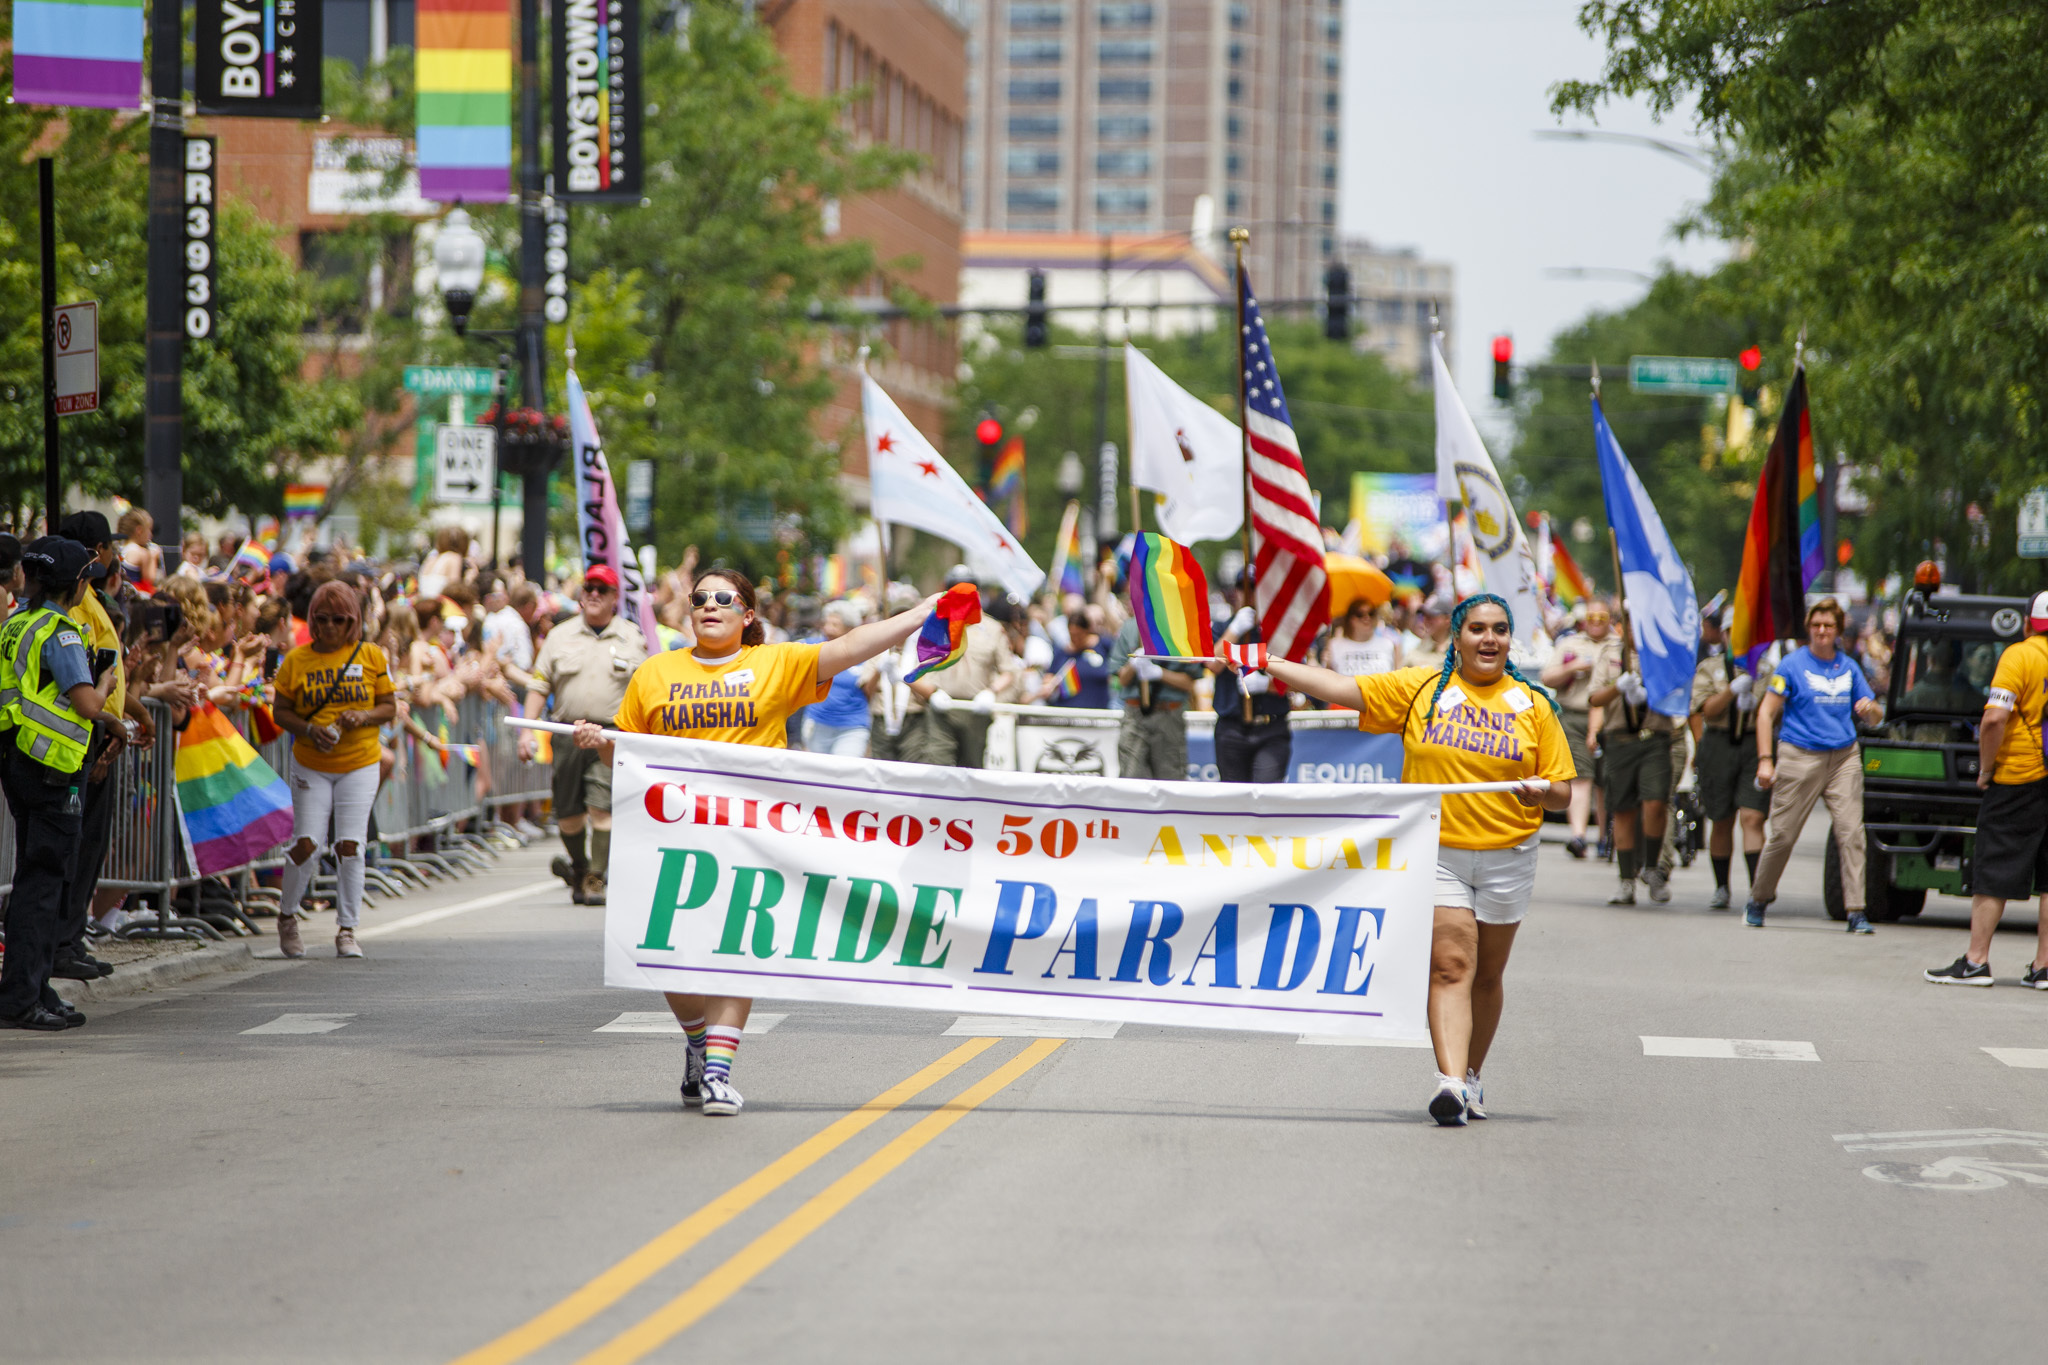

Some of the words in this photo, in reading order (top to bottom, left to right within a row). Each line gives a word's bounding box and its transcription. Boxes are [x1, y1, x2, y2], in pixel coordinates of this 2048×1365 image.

[221, 0, 261, 97] BOY
[185, 138, 212, 339] BR3930
[59, 397, 73, 411] TOW
[75, 394, 95, 409] ZONE
[448, 431, 487, 450] ONE
[669, 680, 750, 701] PARADE
[662, 701, 759, 732] MARSHAL
[1421, 720, 1524, 762] MARSHAL
[1298, 763, 1397, 784] EQUAL.
[644, 781, 974, 852] CHICAGO'S
[997, 813, 1121, 859] 50th
[1142, 825, 1409, 872] ANNUAL
[636, 846, 964, 969] PRIDE
[973, 879, 1387, 997] PARADE
